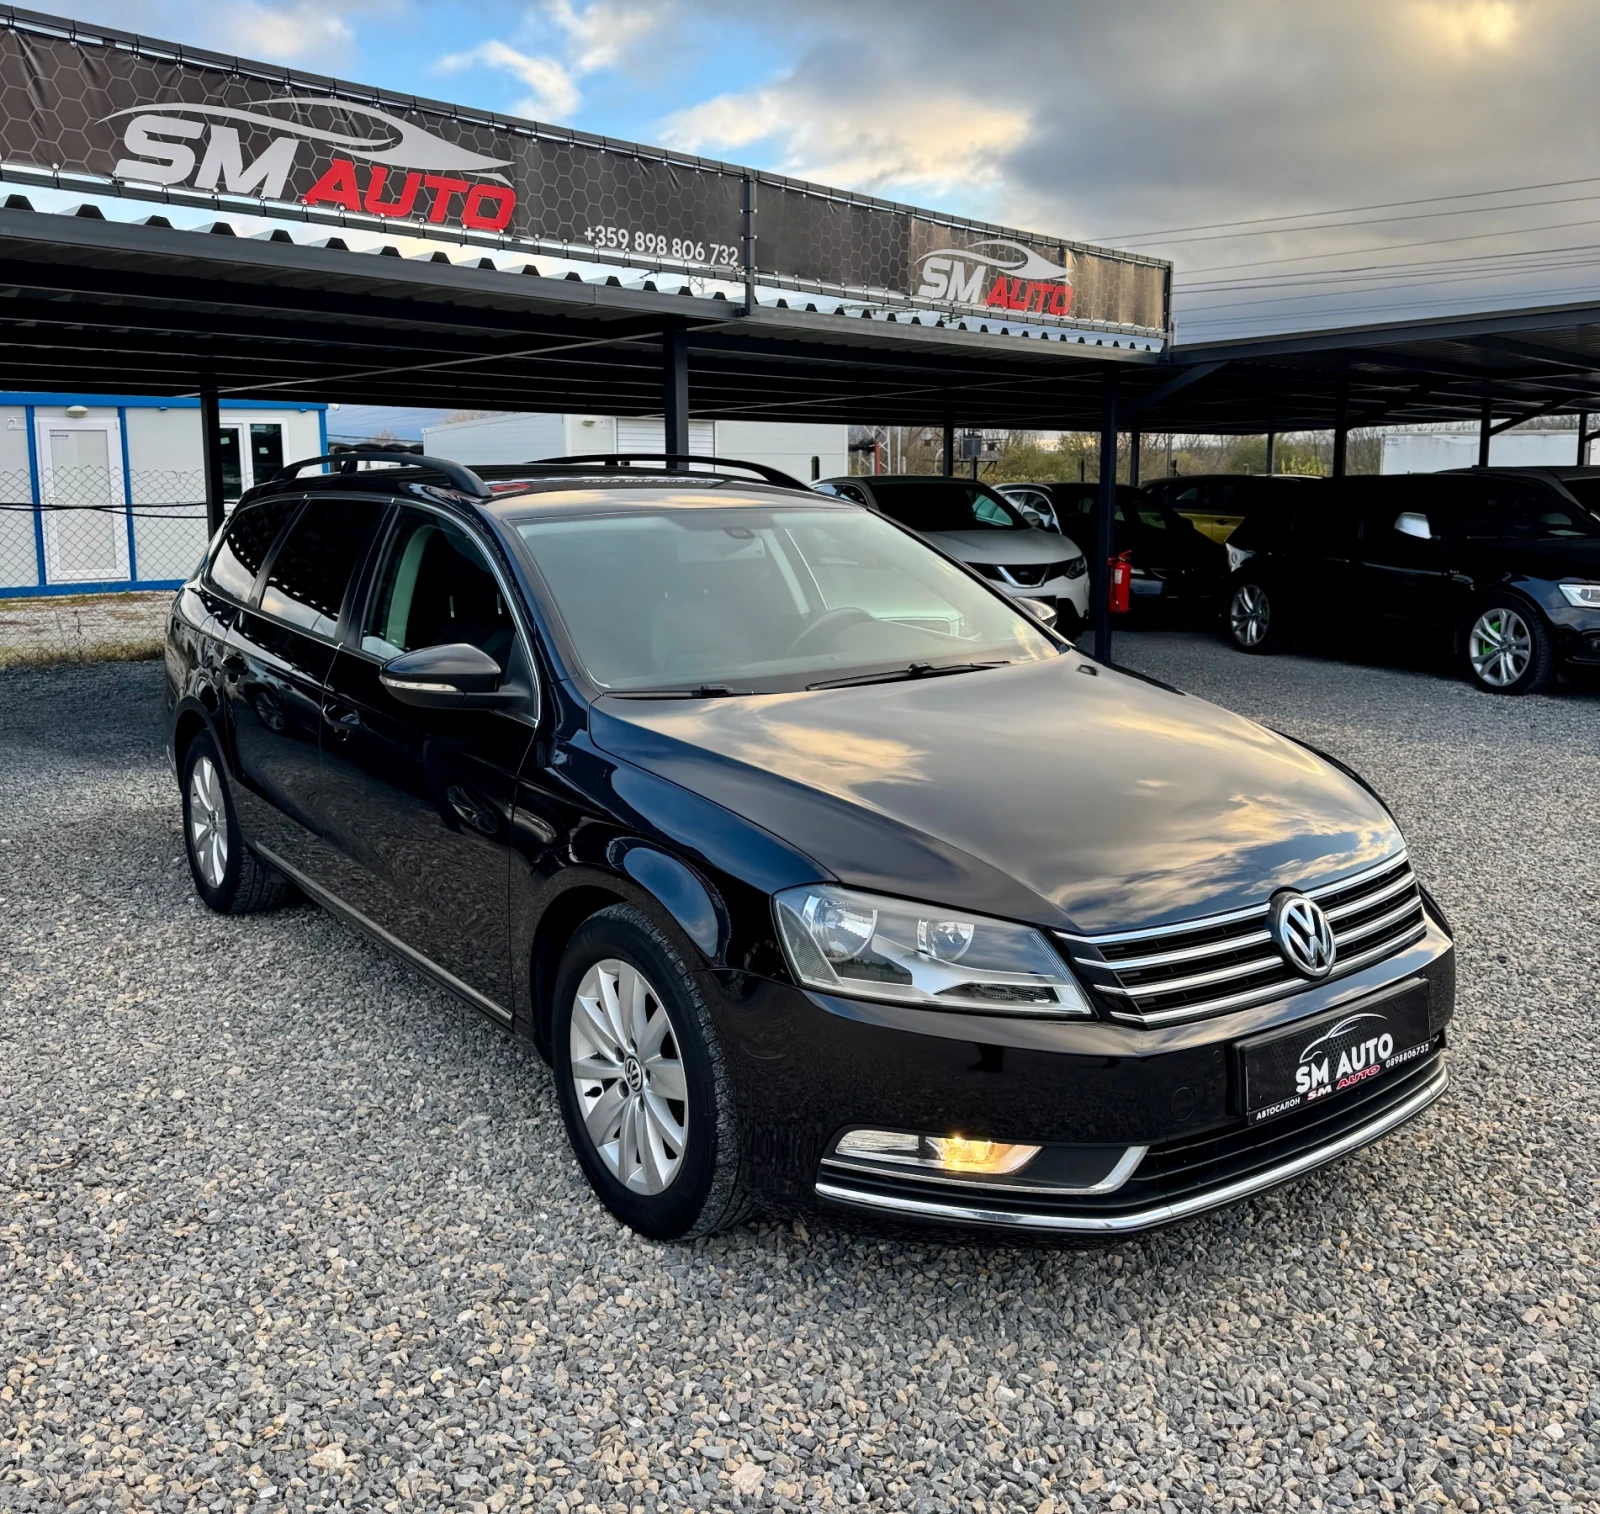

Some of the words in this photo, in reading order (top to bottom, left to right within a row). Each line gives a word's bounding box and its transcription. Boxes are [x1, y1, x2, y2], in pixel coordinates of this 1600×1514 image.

[114, 114, 299, 198] SM
[304, 158, 516, 230] AUTO
[584, 225, 629, 249] +359
[634, 231, 667, 256] 898
[671, 238, 706, 261] 806
[709, 243, 739, 266] 732
[918, 257, 986, 304] SM
[986, 277, 1073, 316] AUTO
[1256, 1097, 1300, 1120] АВТОСАЛОН
[1307, 1085, 1332, 1101] SM
[1336, 1064, 1381, 1090] AUTO
[1386, 1043, 1429, 1069] 0898806732
[1295, 1057, 1329, 1093] SM
[1336, 1033, 1394, 1079] AUTO
